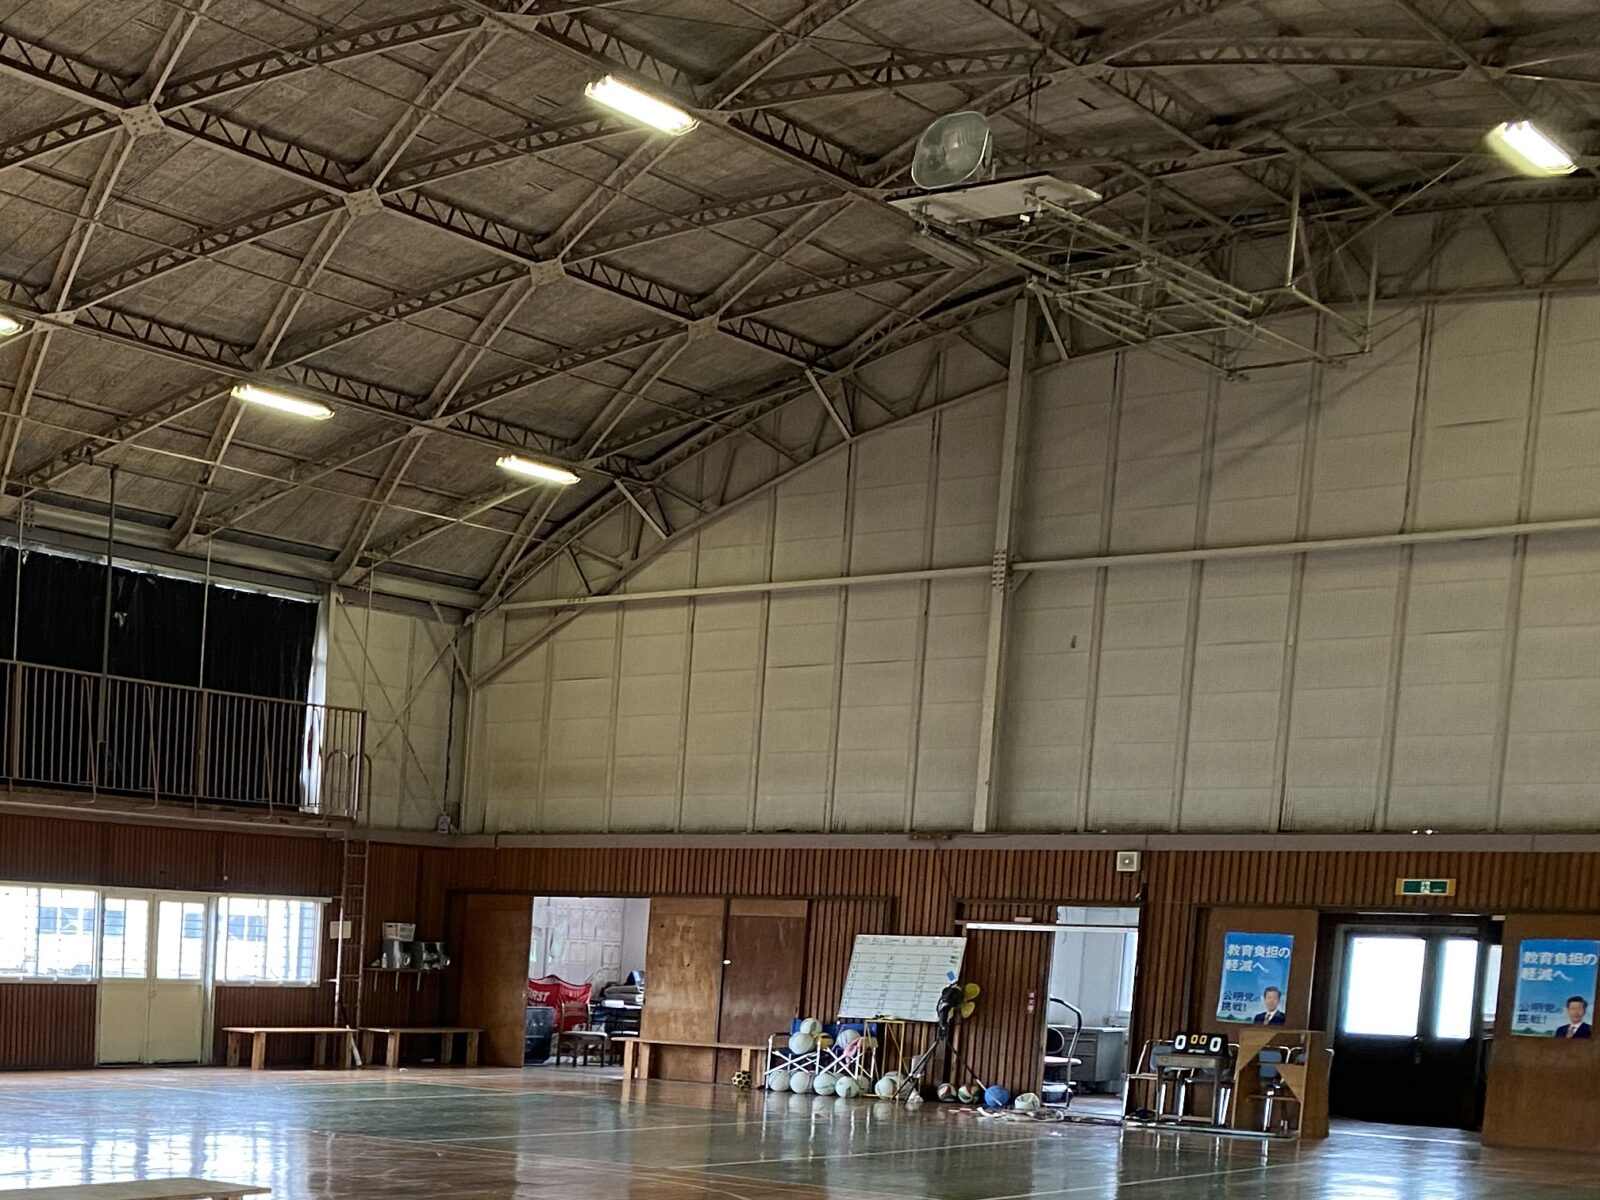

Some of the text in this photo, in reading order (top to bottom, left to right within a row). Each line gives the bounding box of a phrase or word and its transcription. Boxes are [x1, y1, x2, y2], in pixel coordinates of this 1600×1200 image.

[1227, 944, 1291, 959] 教育負担の
[1523, 951, 1598, 966] 教育負担の
[1174, 1034, 1187, 1050] 0
[1209, 1036, 1222, 1052] 0
